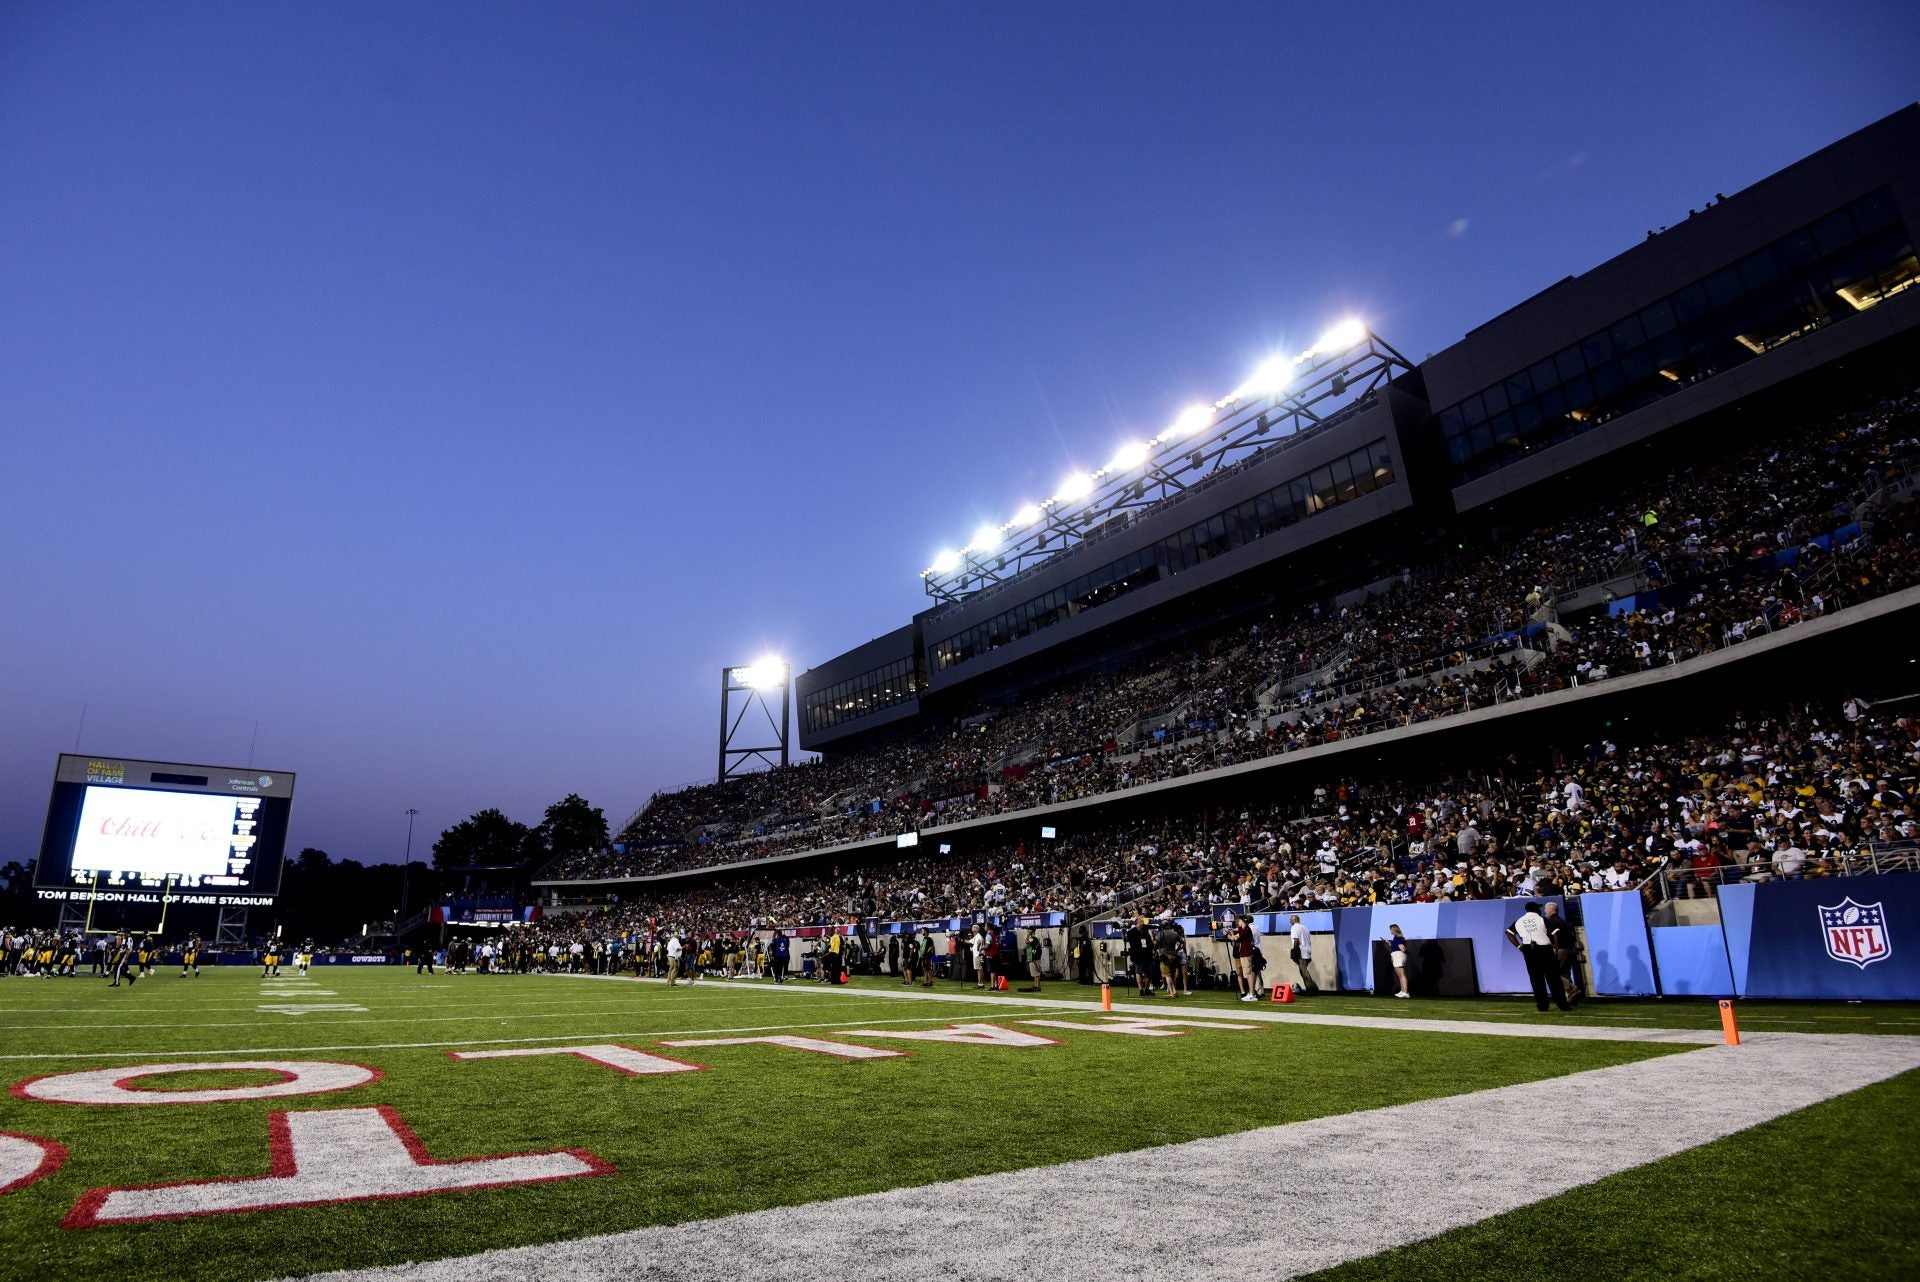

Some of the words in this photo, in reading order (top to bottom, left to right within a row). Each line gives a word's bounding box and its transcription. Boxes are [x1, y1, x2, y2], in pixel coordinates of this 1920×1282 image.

[88, 761, 109, 769] HALL
[87, 767, 100, 775] OF
[102, 769, 126, 777] FAME
[86, 774, 125, 784] VILLAGE
[228, 778, 255, 786] Johnson
[232, 784, 259, 792] Controls
[37, 890, 68, 900] TOM
[69, 892, 125, 902] BENSON
[127, 894, 160, 903] HALL
[162, 895, 181, 903] OF
[182, 895, 216, 904] FAME
[218, 897, 274, 906] STADIUM
[1830, 928, 1884, 959] NFL
[351, 955, 386, 963] COWBOYS
[1274, 985, 1286, 1000] G
